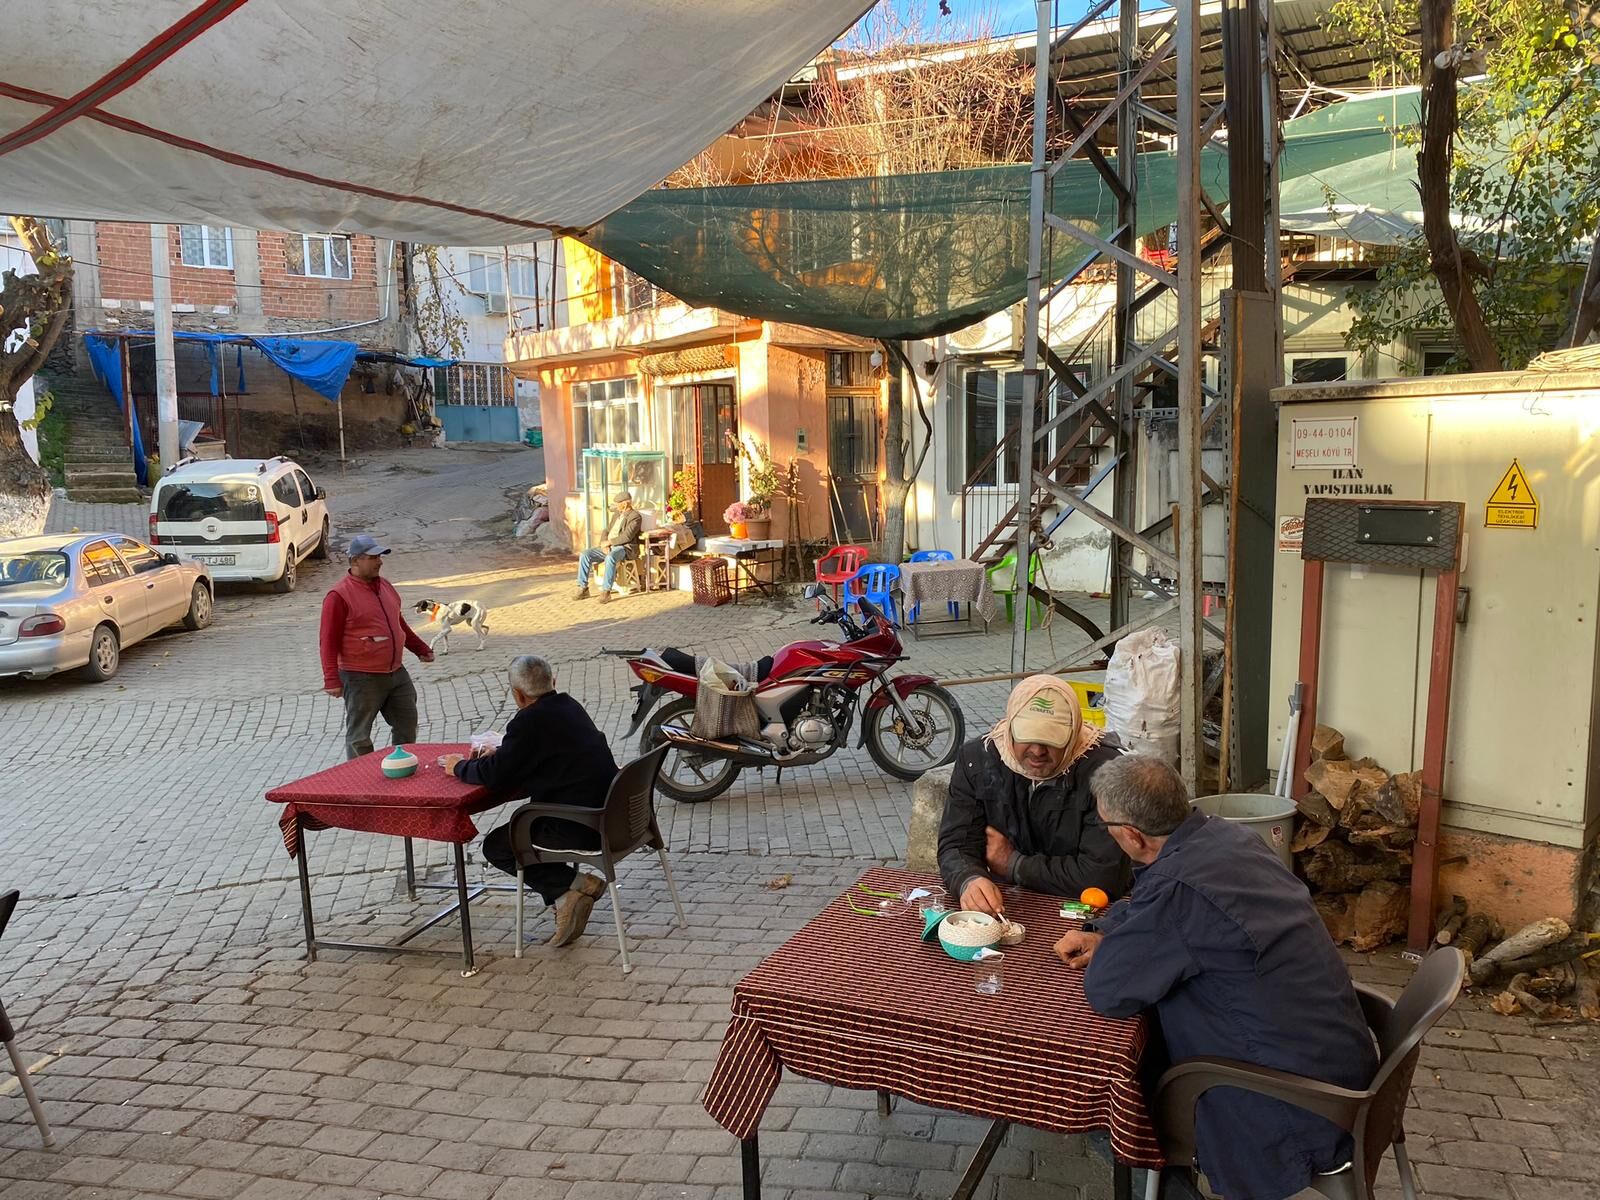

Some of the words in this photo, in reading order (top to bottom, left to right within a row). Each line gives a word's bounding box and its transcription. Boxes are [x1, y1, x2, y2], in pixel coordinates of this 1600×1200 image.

[1297, 427, 1352, 439] 09-44-0104
[1322, 446, 1340, 457] KÖYÜ
[1344, 447, 1352, 457] TR
[1304, 484, 1393, 496] YAPIŞTIRMAK
